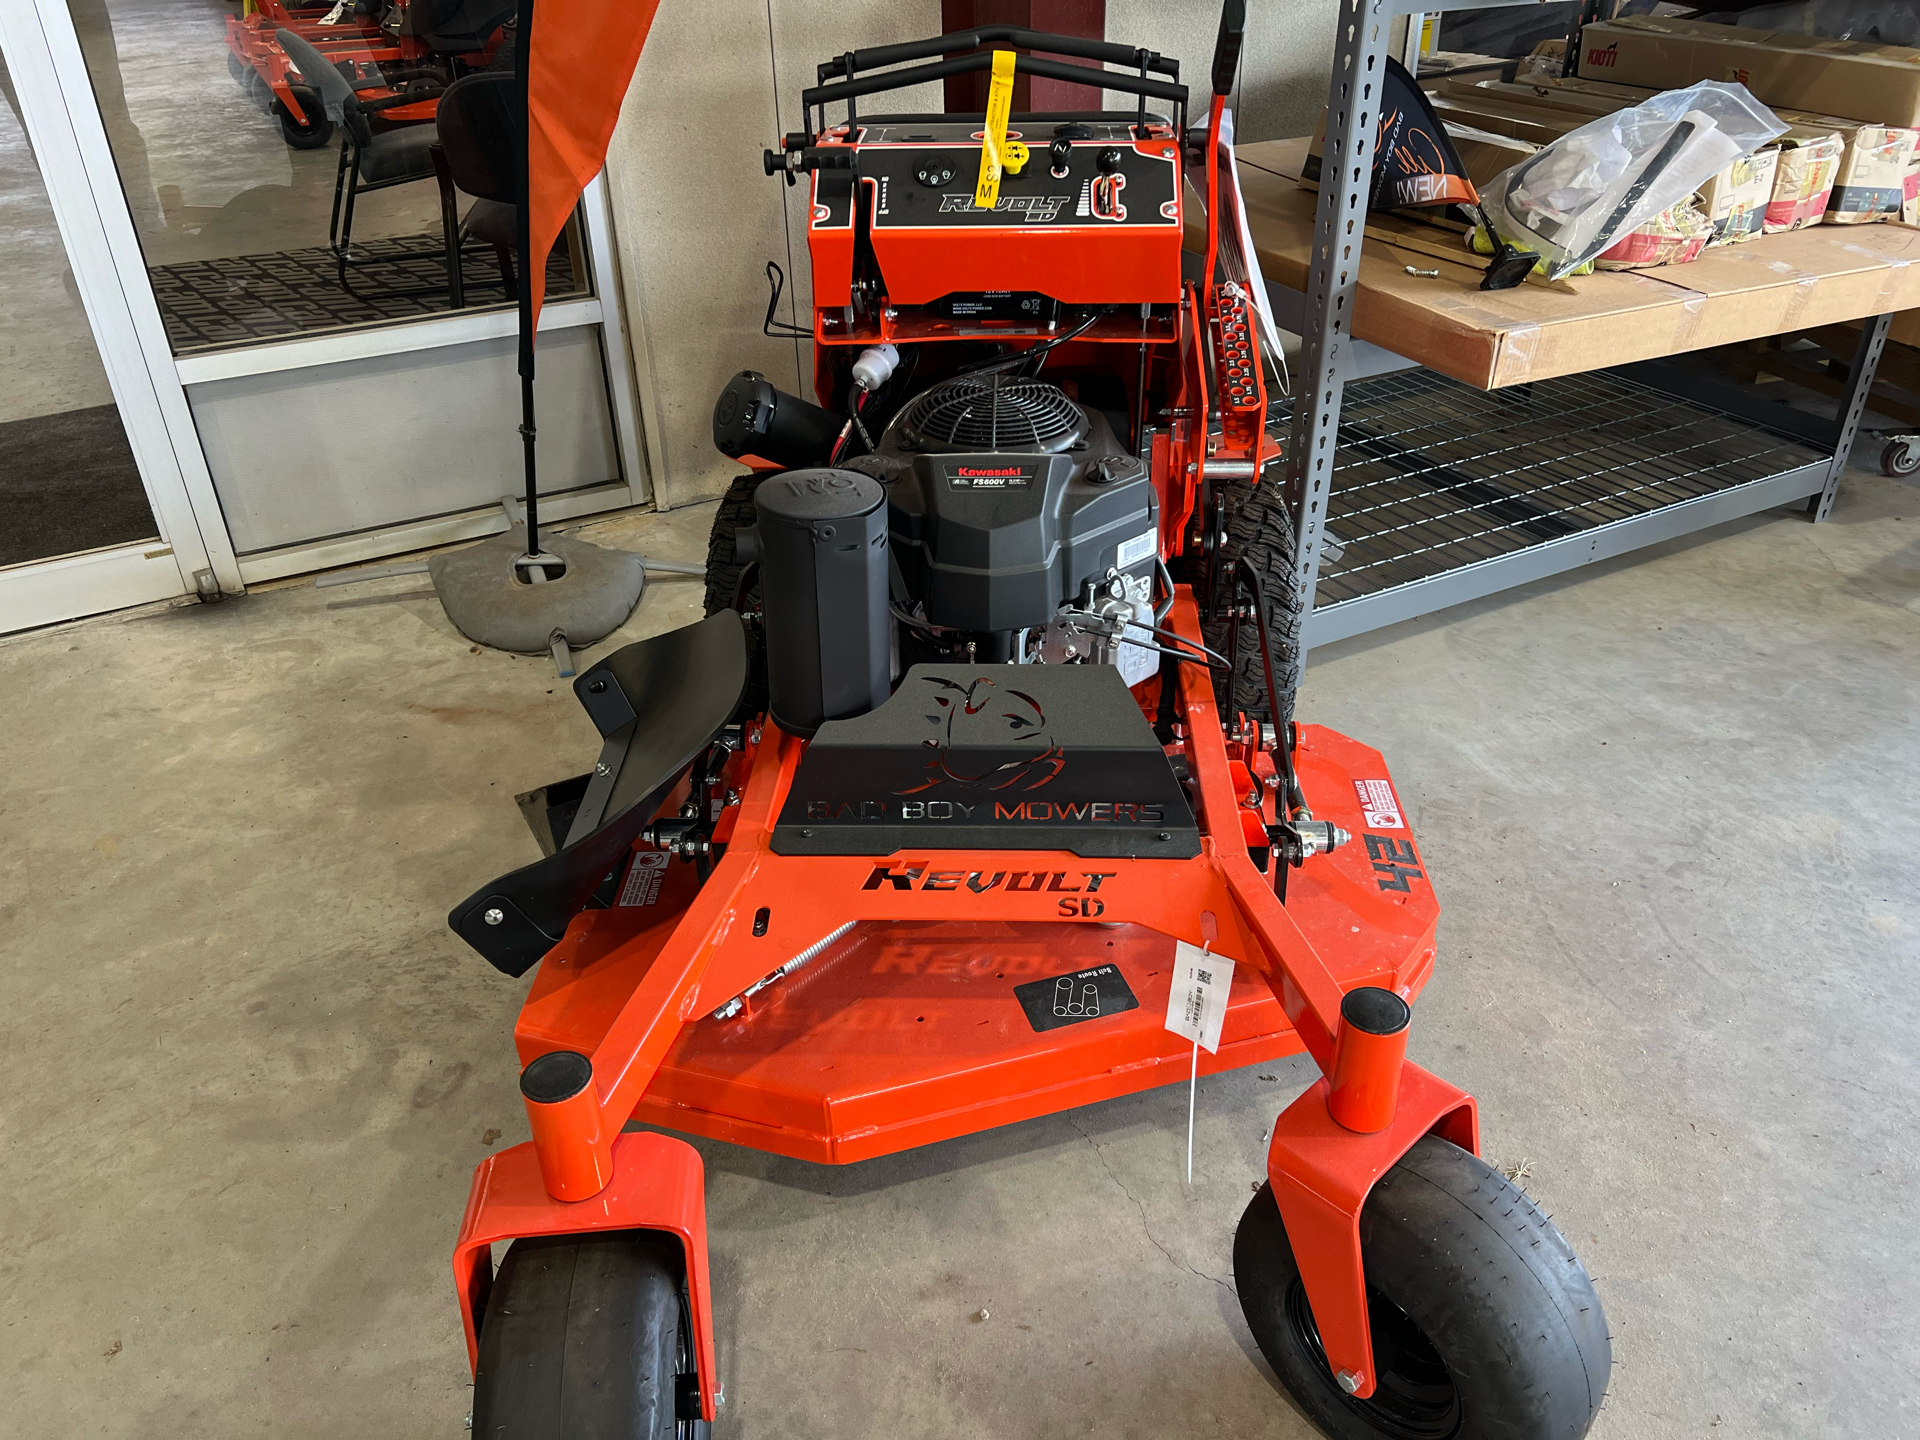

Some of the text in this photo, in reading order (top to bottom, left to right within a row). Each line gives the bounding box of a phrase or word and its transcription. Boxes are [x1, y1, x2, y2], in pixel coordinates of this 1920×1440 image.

[1587, 48, 1617, 67] KIOTI
[958, 467, 1021, 477] Kawasaki
[807, 801, 1165, 823] BAD BOY MOWERS
[1362, 833, 1424, 893] 42
[860, 859, 1118, 894] REVOLT
[646, 879, 662, 905] DANGER
[1057, 897, 1106, 918] SD
[1077, 966, 1113, 979] Belt Route
